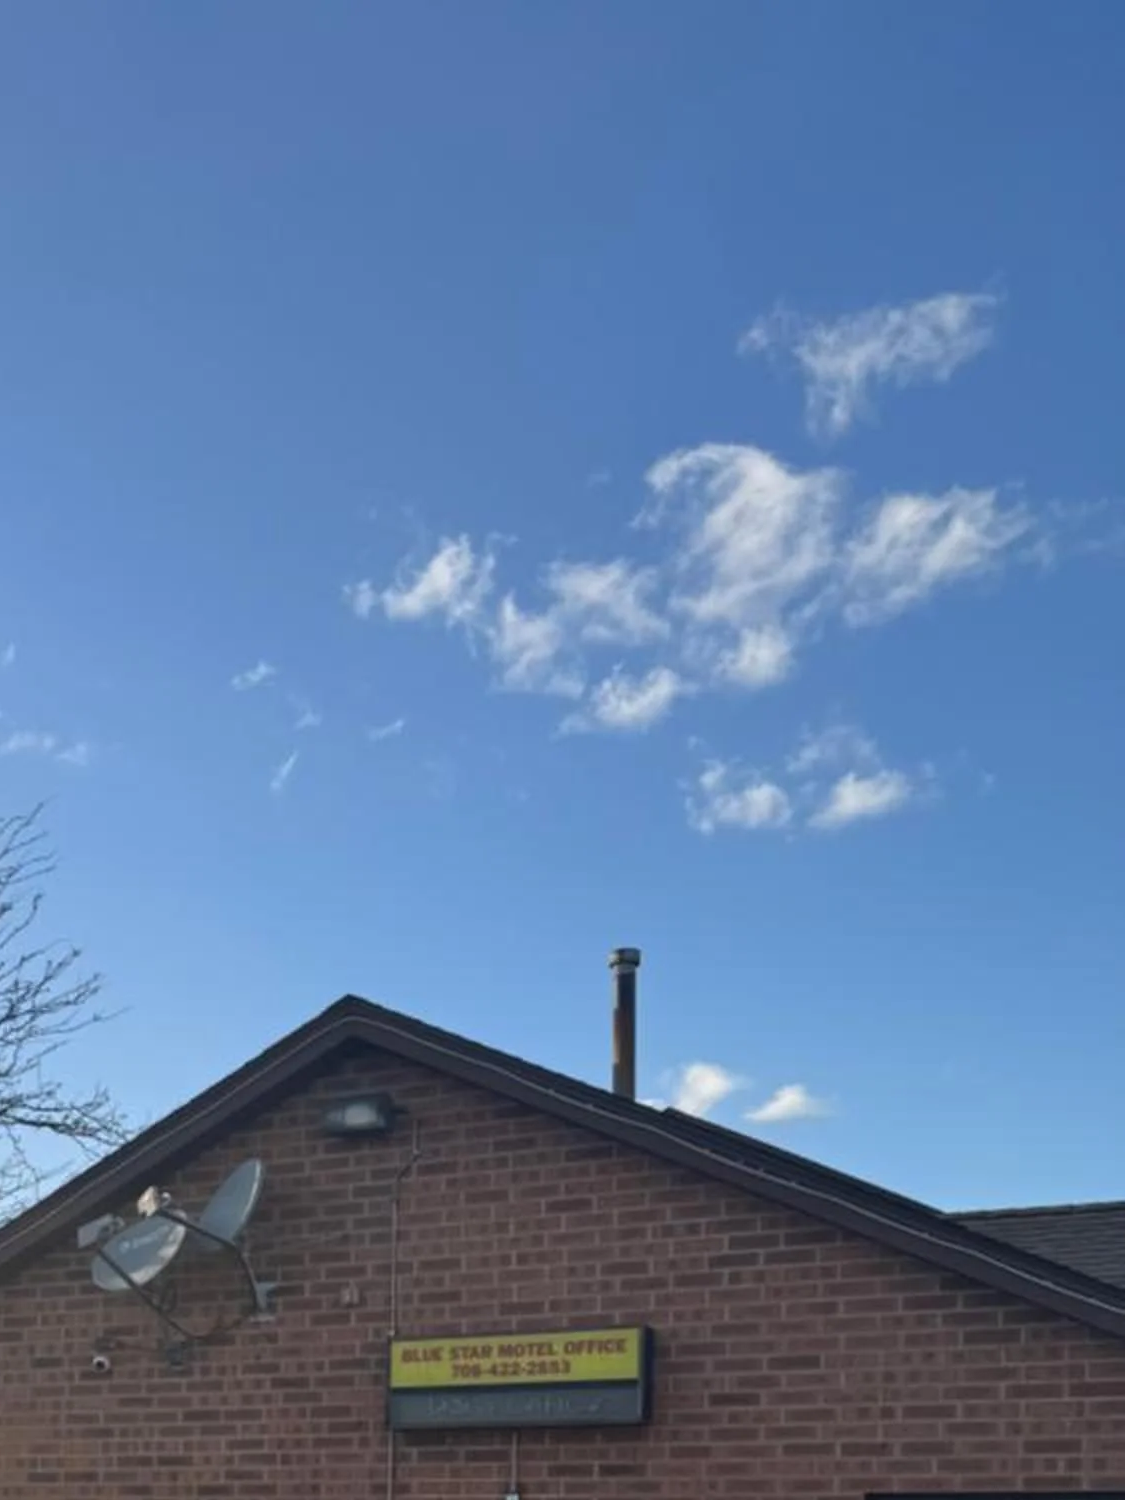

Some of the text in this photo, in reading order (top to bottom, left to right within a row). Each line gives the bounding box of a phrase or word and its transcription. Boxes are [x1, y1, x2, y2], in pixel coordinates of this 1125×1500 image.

[402, 1338, 627, 1363] BLUE STAR MOTEL OFFICE
